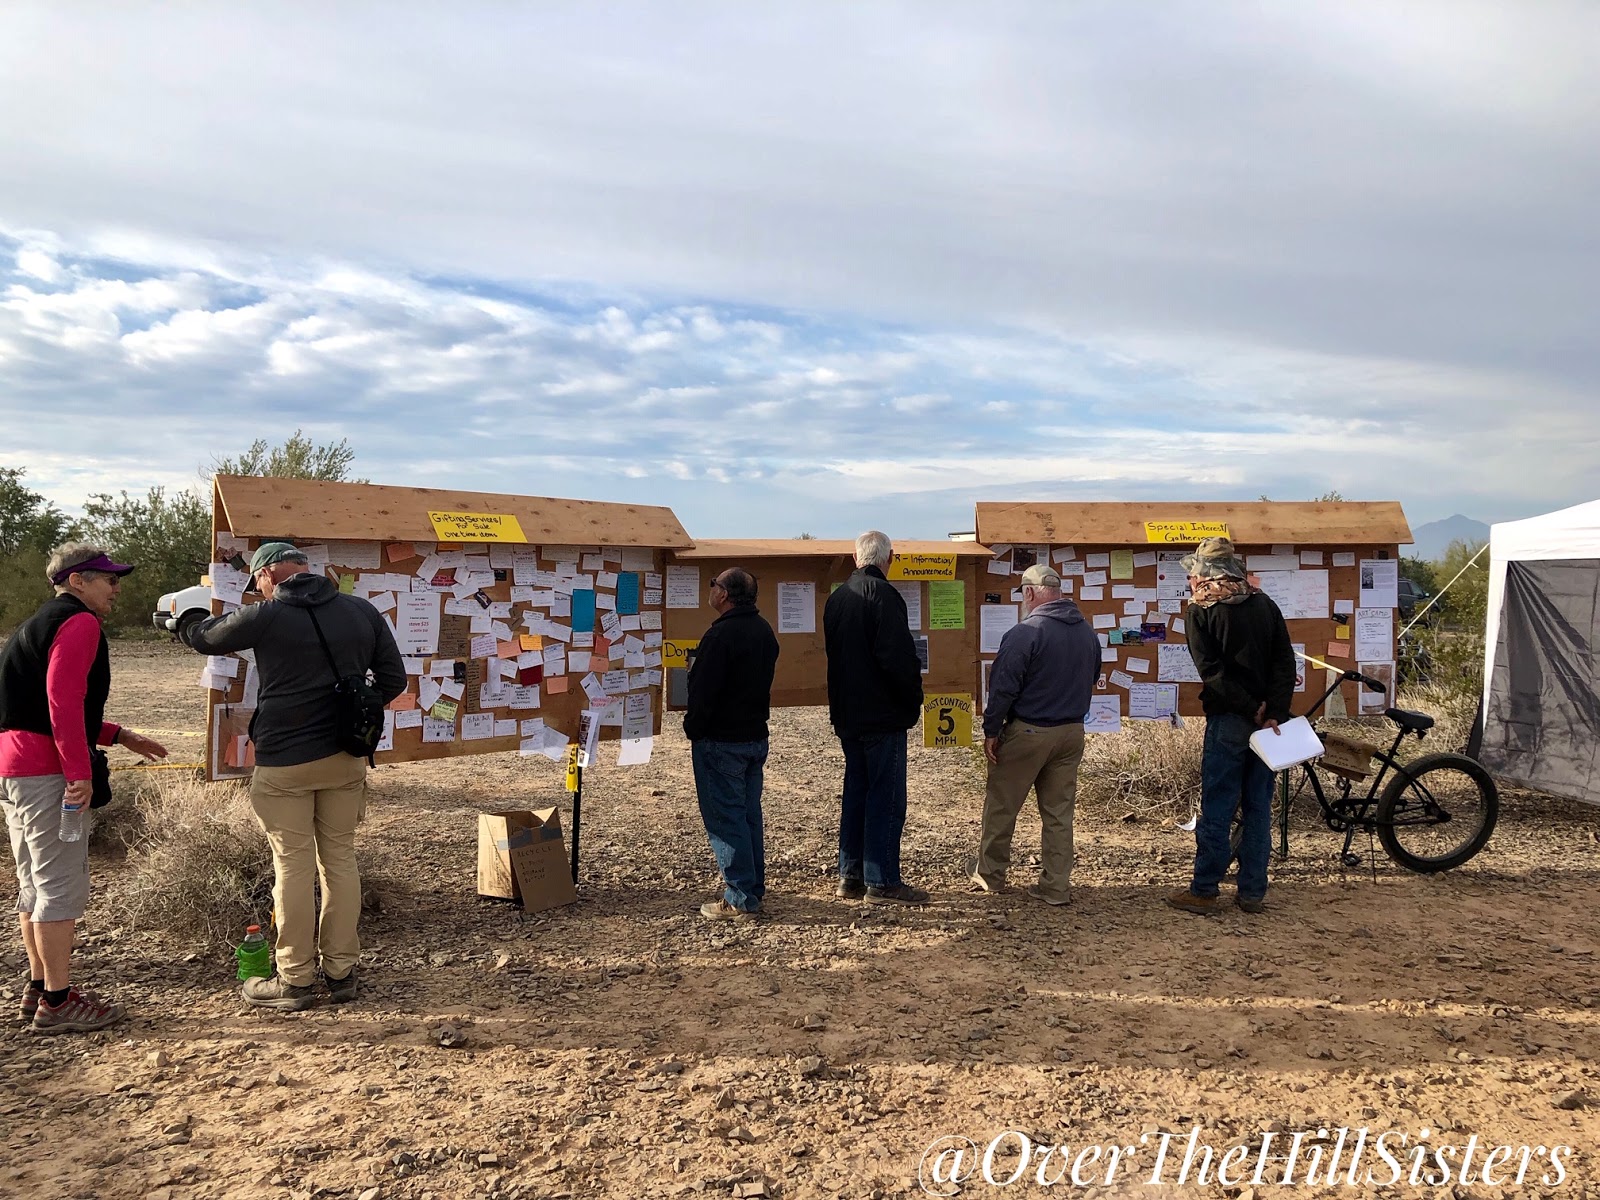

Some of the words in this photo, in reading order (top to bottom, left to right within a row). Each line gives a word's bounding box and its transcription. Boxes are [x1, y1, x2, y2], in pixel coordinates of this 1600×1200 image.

[432, 513, 465, 524] Gifting
[1147, 522, 1187, 532] Special
[902, 568, 953, 577] Announcements
[924, 698, 939, 713] DUST
[940, 697, 970, 713] CONTROL
[937, 708, 955, 735] 5
[935, 736, 957, 746] MPH
